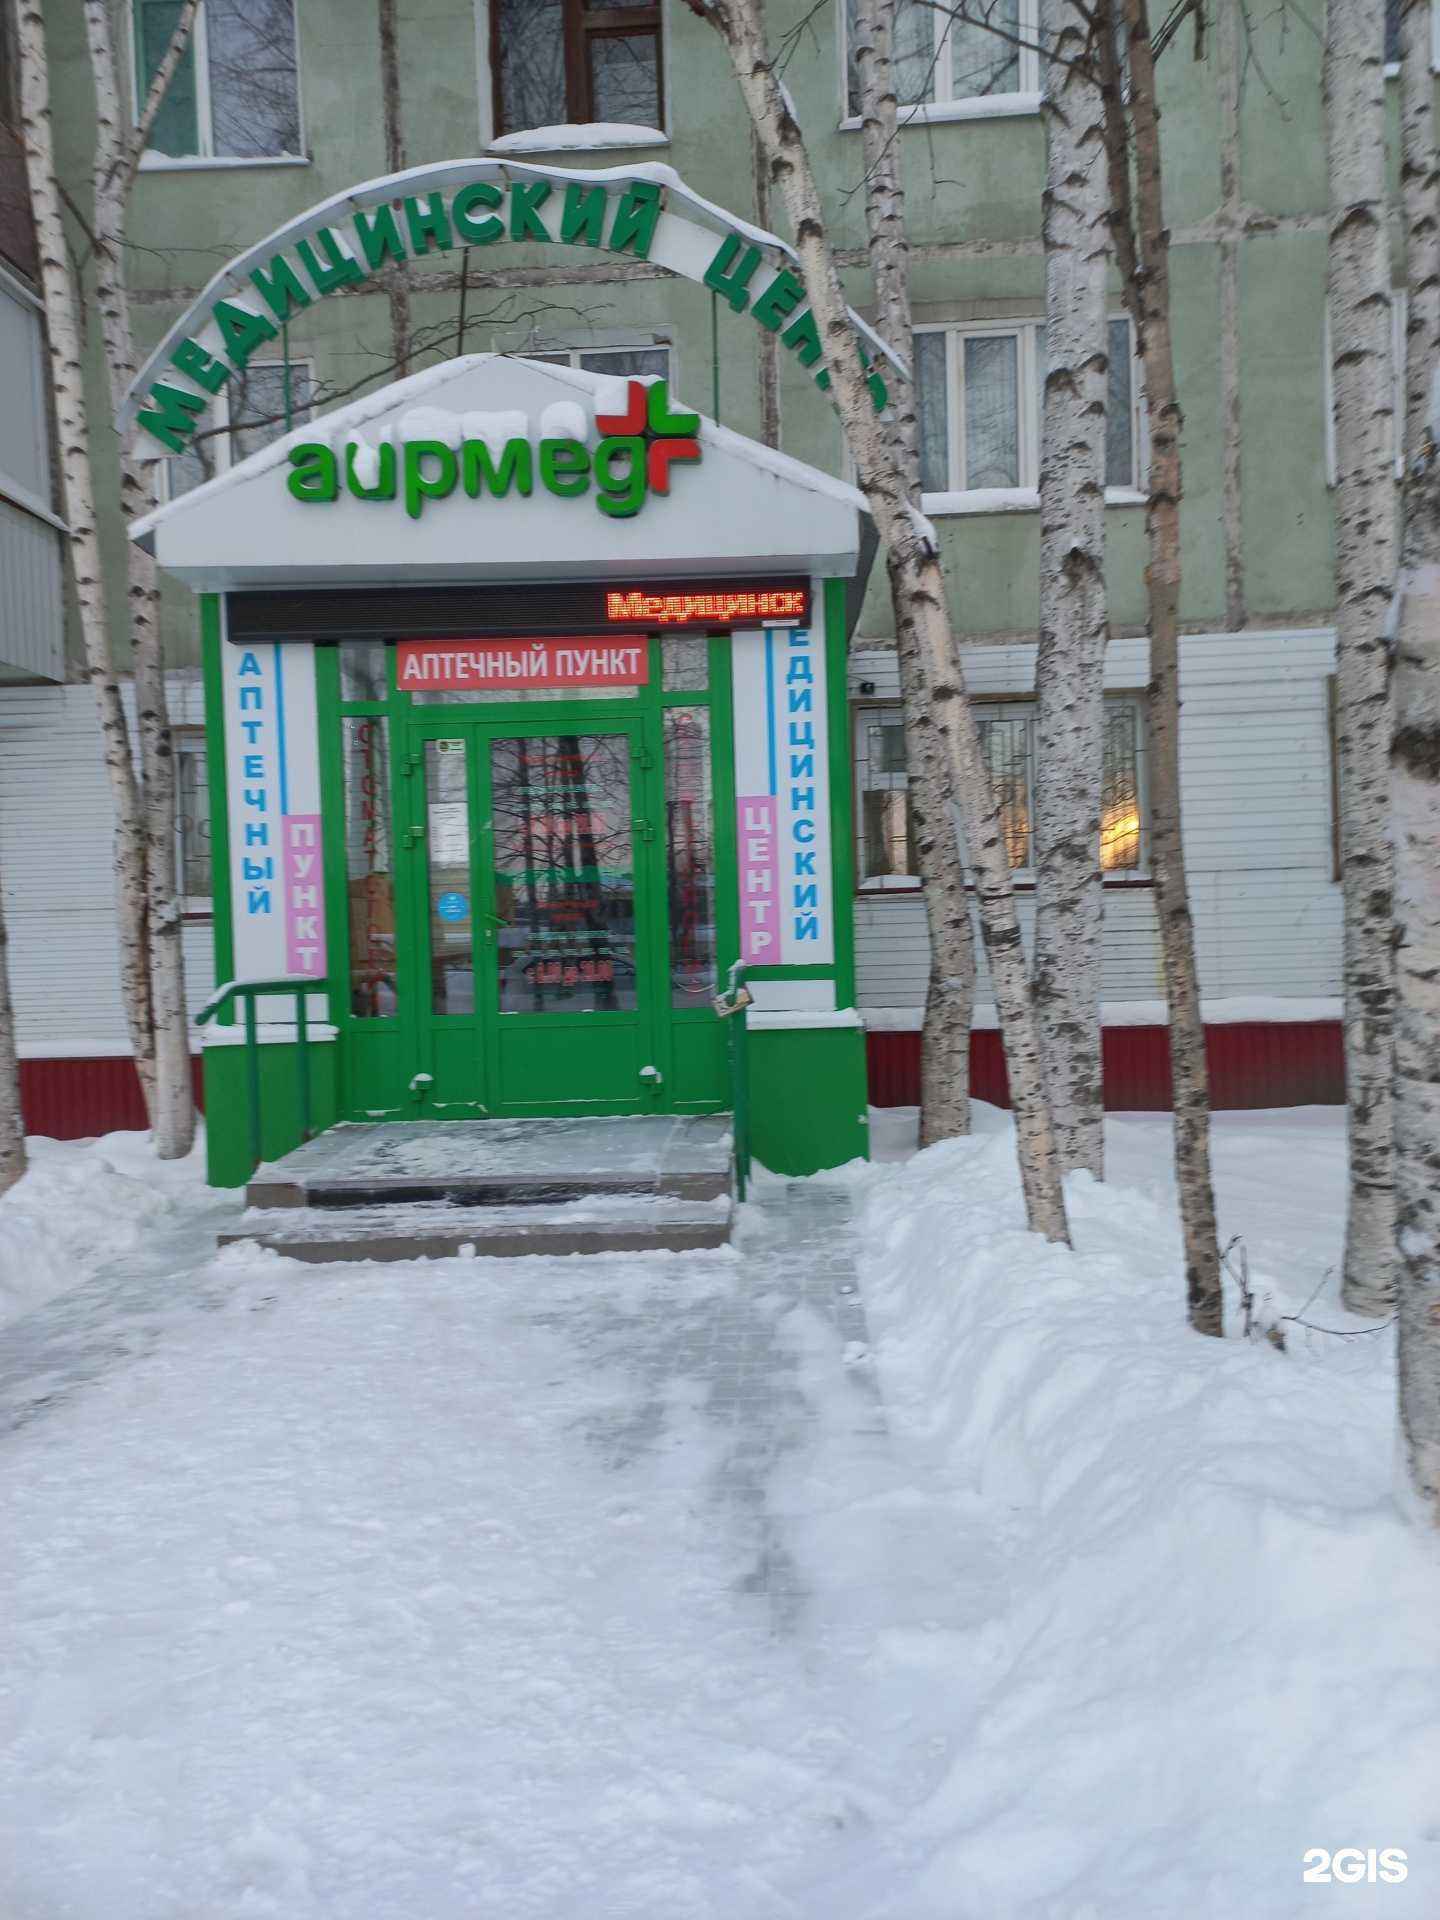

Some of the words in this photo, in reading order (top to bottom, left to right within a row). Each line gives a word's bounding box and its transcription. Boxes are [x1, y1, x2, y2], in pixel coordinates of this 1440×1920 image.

[135, 180, 665, 455] МЕДИЦИНСКИЙ
[403, 642, 549, 680] АПТЕЧНЫЙ
[556, 648, 642, 677] ПУНКТ
[785, 628, 819, 941] ЕДИЦИНСКИЙ
[237, 652, 275, 915] АПТЕЧНЫЙ
[289, 823, 320, 971] ПУНКТ
[744, 806, 773, 955] ЦЕНТР
